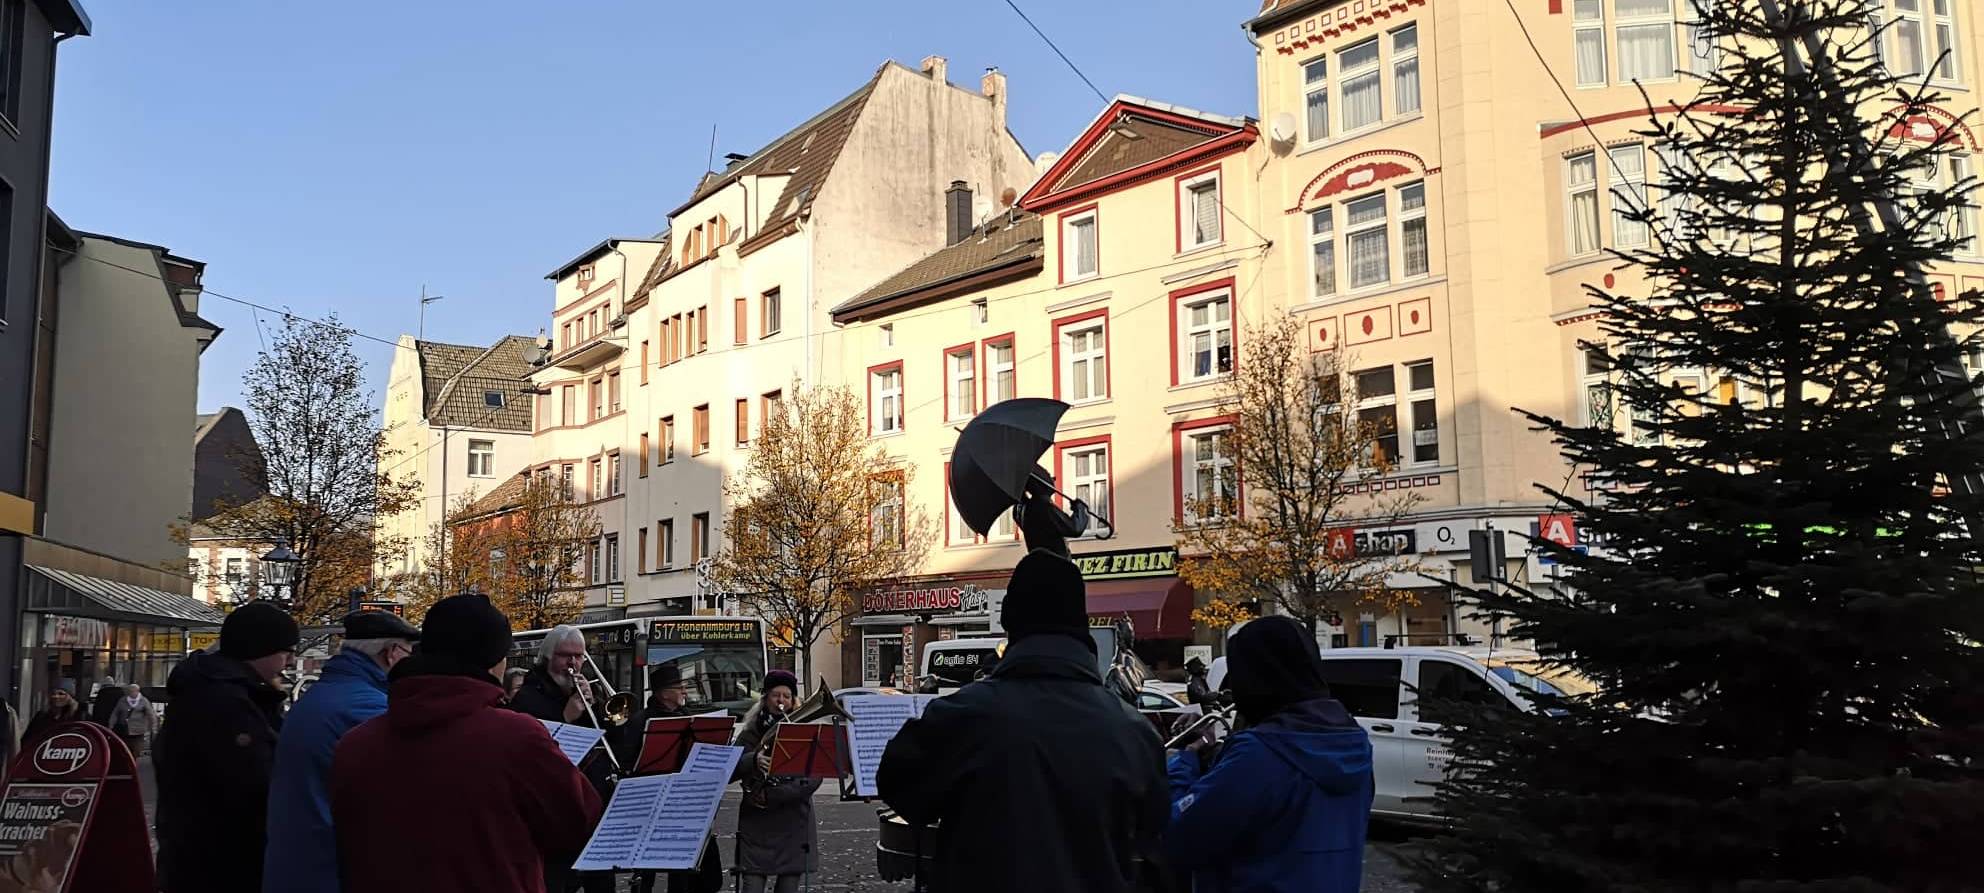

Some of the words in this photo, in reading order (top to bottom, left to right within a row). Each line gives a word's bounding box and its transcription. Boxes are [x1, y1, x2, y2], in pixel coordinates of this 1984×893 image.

[1110, 551, 1177, 573] FIRIN
[863, 587, 960, 613] DÖNERHAUS
[654, 623, 676, 640] 517
[966, 654, 979, 665] 24
[41, 740, 87, 770] kamp
[4, 802, 64, 820] Walnuss-
